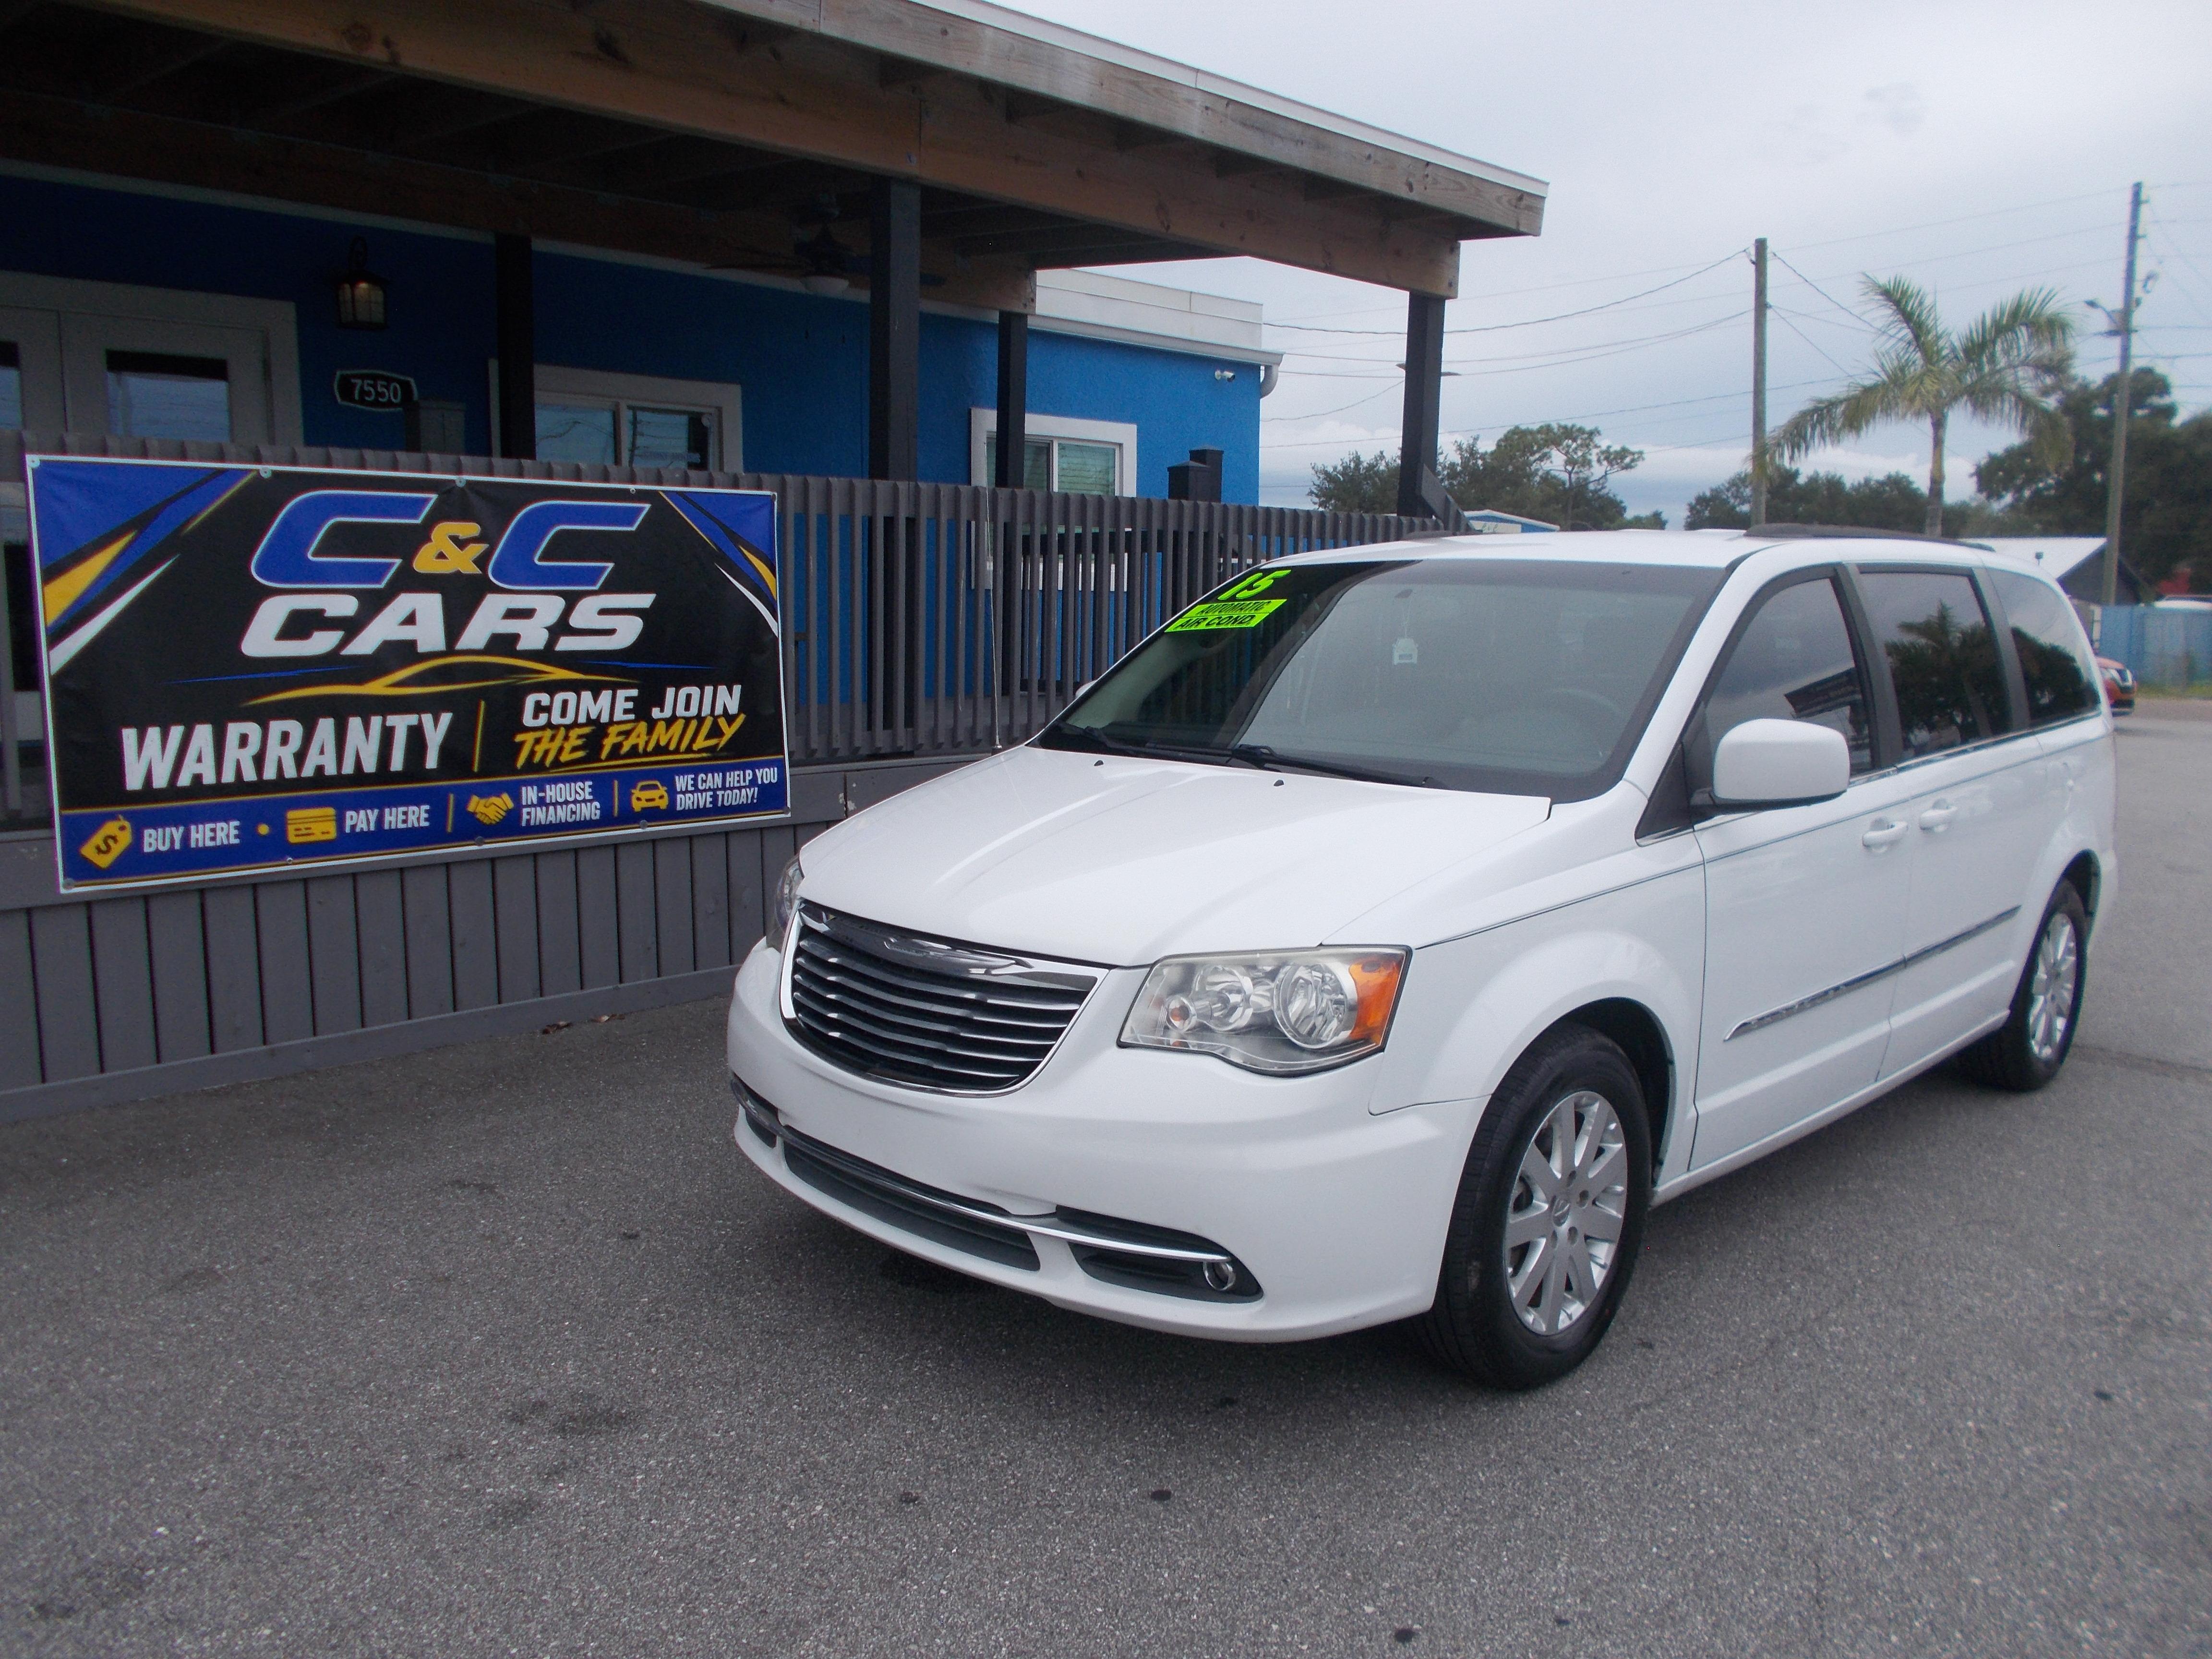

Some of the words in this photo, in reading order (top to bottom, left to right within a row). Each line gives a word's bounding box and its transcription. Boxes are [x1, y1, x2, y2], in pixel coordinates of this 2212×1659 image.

[351, 379, 401, 403] 7550
[1217, 570, 1291, 600] 15
[1198, 601, 1272, 614] AUTOMATIC
[241, 593, 656, 657] CARS
[1176, 617, 1208, 629] AIR
[523, 689, 638, 727] COME
[652, 685, 742, 719] JOIN
[121, 713, 453, 791] WARRANTY
[515, 726, 596, 769] THE
[601, 713, 746, 760] FAMILY
[675, 774, 695, 792] WE
[697, 772, 723, 790] CAN
[725, 770, 753, 787] HELP
[755, 767, 778, 784] YOU
[521, 781, 593, 805] IN-HOUSE
[676, 793, 713, 812] DRIVE
[716, 788, 758, 806] TODAY!
[345, 810, 379, 833] PAY
[384, 805, 430, 829] HERE
[521, 802, 601, 826] FINANCING
[144, 827, 184, 853] BUY
[191, 821, 240, 848] HERE
